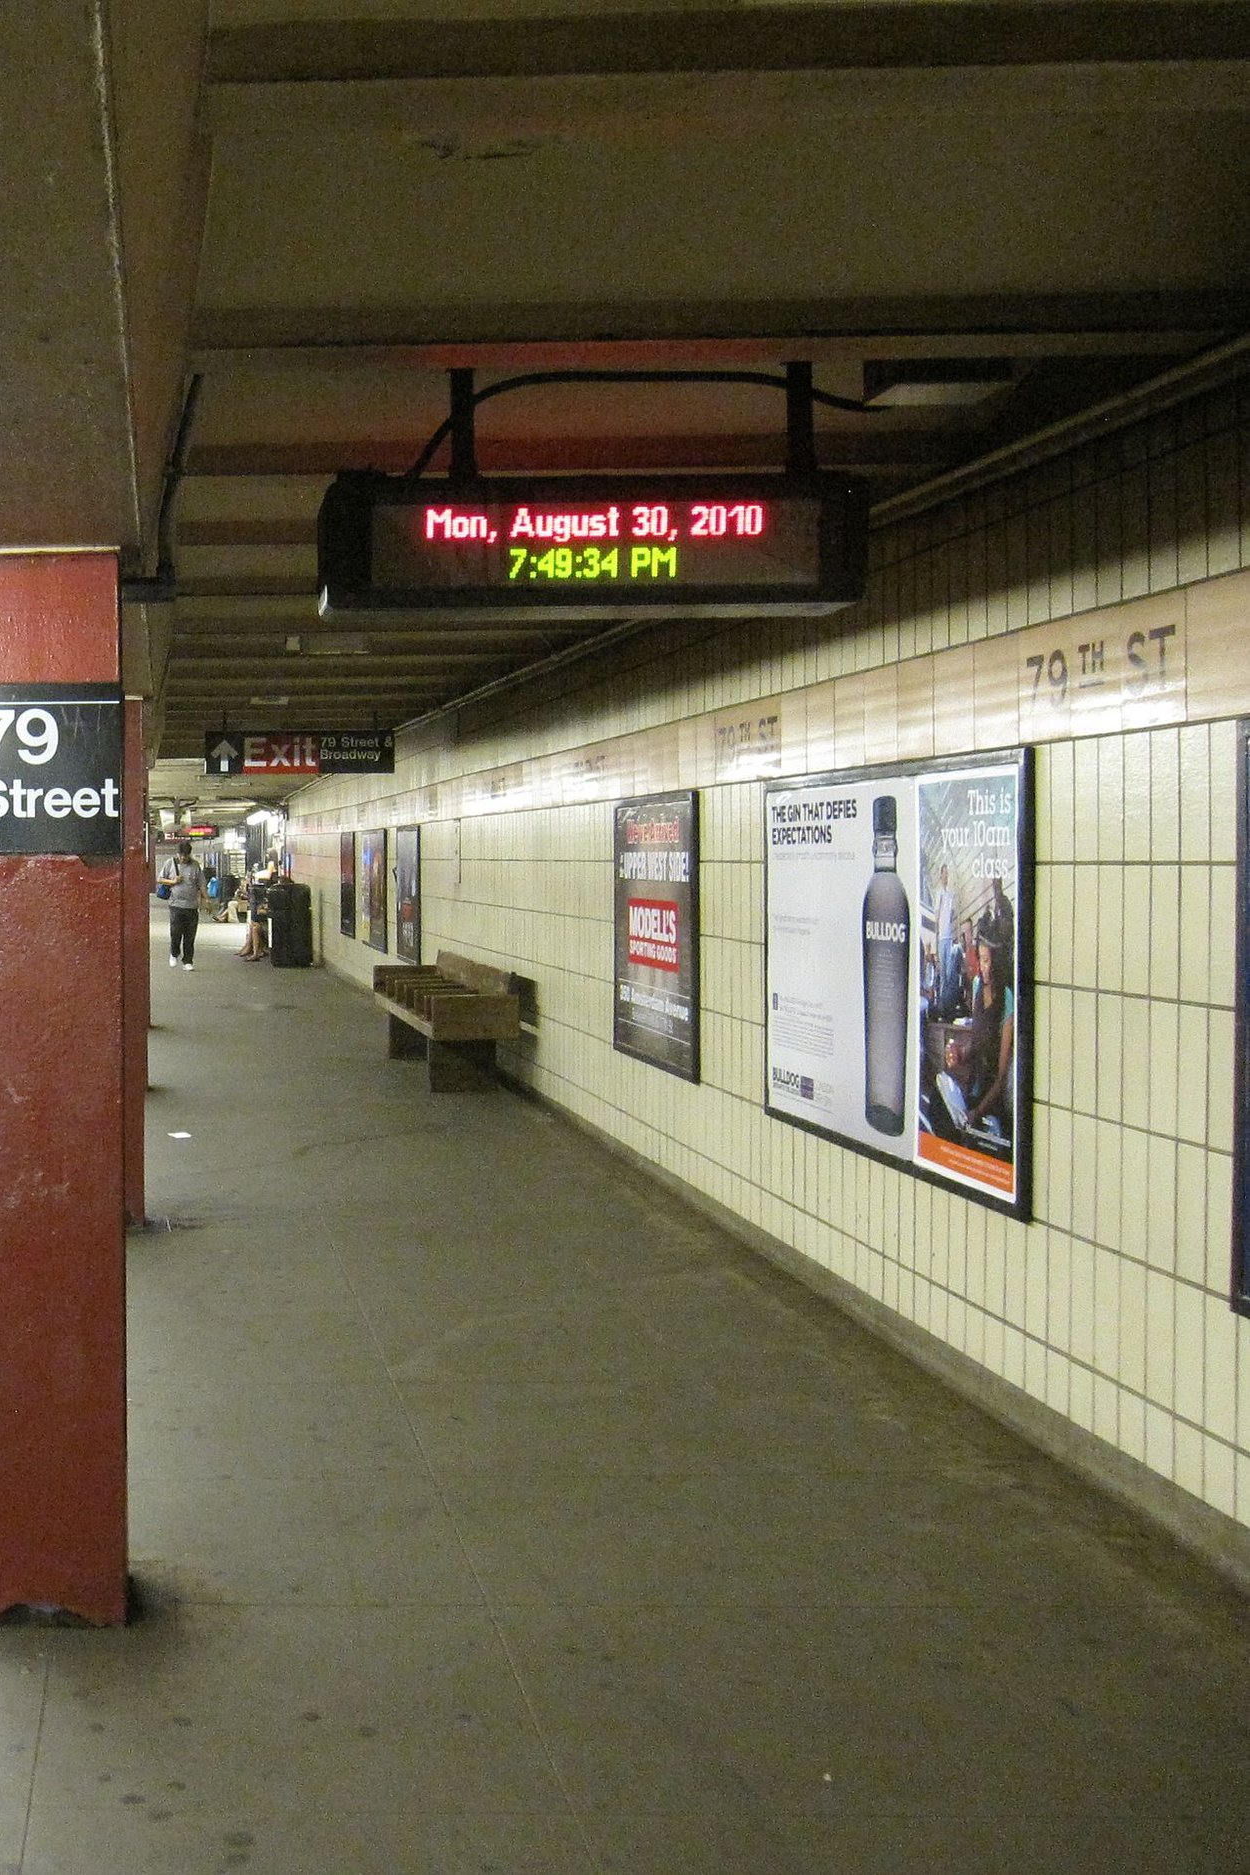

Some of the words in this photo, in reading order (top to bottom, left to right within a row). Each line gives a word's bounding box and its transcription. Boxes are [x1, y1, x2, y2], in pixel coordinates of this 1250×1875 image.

[425, 508, 497, 543] Mon,
[509, 507, 620, 542] August
[632, 505, 678, 541] 30,
[690, 504, 764, 536] 2010
[509, 547, 618, 579] 7:49:34
[631, 546, 677, 578] PM
[1127, 624, 1176, 695] ST
[244, 737, 317, 767] Exit
[320, 750, 381, 761] Broadway
[321, 737, 337, 748] 79
[341, 737, 379, 748] Street
[384, 737, 393, 748] &
[771, 805, 786, 823] THE
[787, 804, 801, 822] GIN
[802, 801, 824, 821] THAT
[826, 799, 857, 819] DEFIES
[967, 789, 996, 815] This
[999, 787, 1011, 814] is
[772, 825, 832, 845] EXPECTATIONS
[941, 827, 970, 853] your
[973, 820, 1010, 847] 10am
[629, 905, 677, 944] MODELL'S
[866, 921, 906, 943] BULLDOG
[630, 939, 656, 960] SPORTING
[657, 945, 677, 964] GOODS
